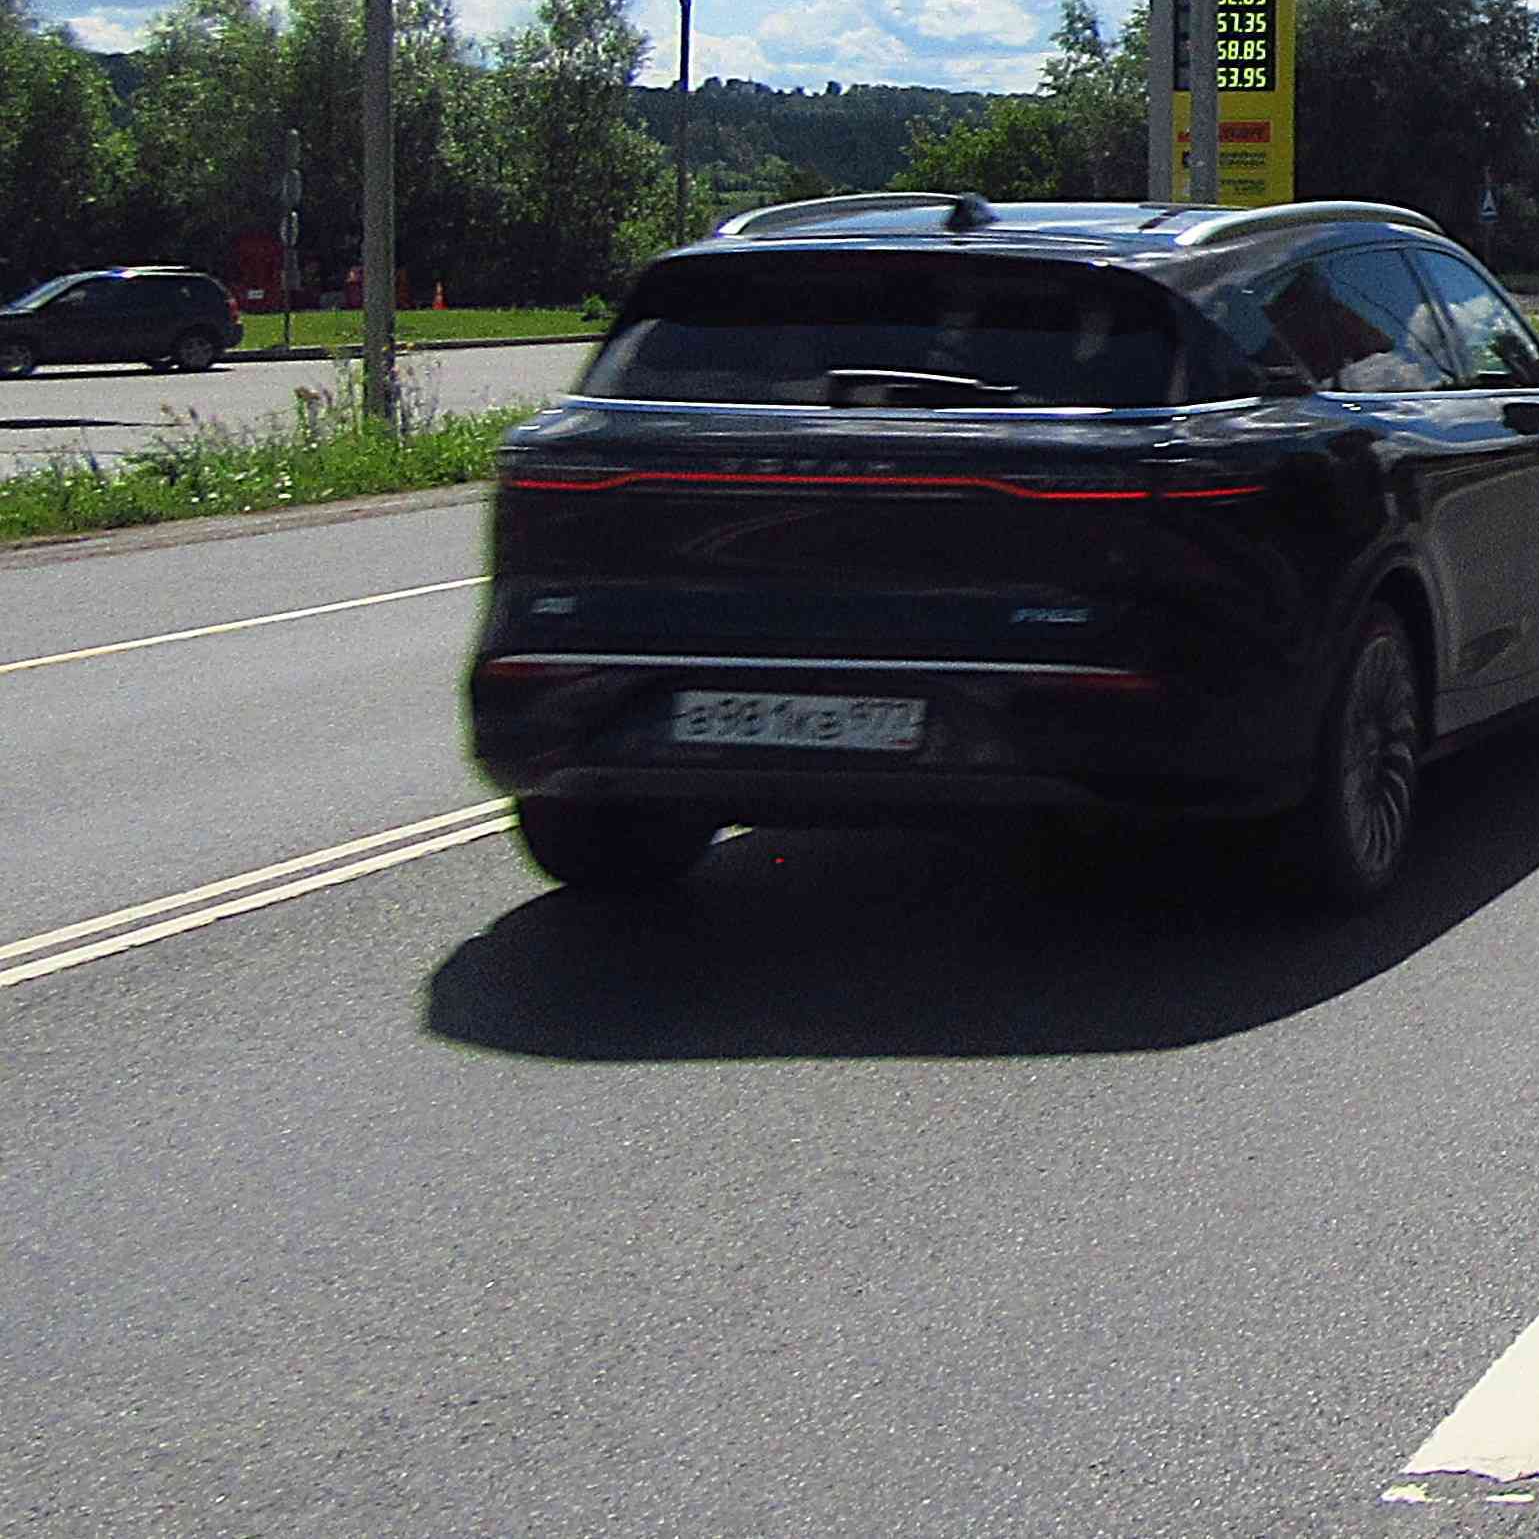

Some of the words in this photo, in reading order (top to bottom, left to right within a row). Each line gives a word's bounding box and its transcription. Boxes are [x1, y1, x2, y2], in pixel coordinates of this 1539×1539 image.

[1216, 12, 1267, 33] 57.35
[1216, 40, 1267, 60] 58.85
[1216, 67, 1267, 88] 53.95
